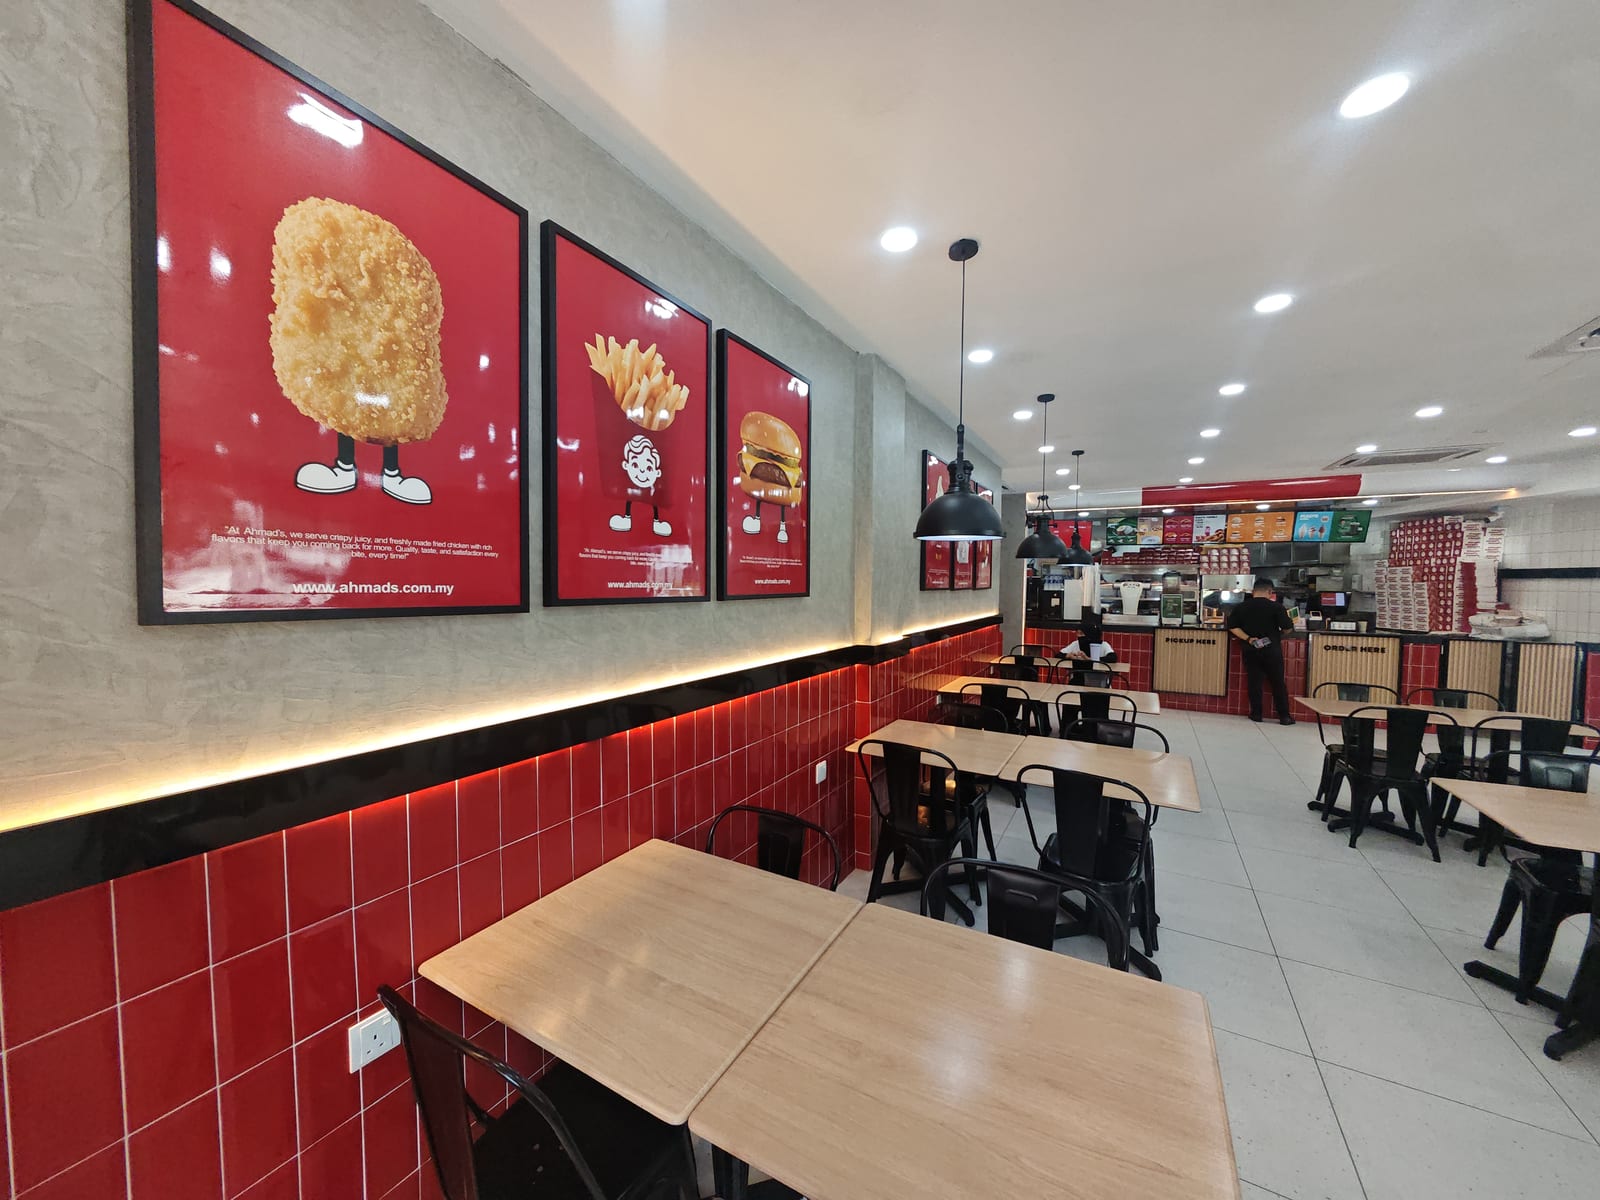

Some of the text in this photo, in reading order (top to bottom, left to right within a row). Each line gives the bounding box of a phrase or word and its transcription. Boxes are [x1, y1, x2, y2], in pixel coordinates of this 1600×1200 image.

[211, 533, 245, 543] flavors
[247, 535, 266, 545] that
[267, 537, 290, 547] keep
[292, 540, 308, 548] you
[310, 540, 340, 551] coming
[342, 541, 361, 550] back
[362, 543, 373, 551] for
[452, 548, 484, 557] satisfaction
[484, 551, 499, 559] every
[305, 532, 328, 540] serve
[329, 534, 352, 542] crispy
[389, 537, 412, 546] freshly
[413, 539, 432, 547] made
[447, 541, 470, 549] chicken
[482, 543, 493, 551] rich
[368, 552, 388, 560] every
[292, 581, 454, 596] www.ahmads.com.my
